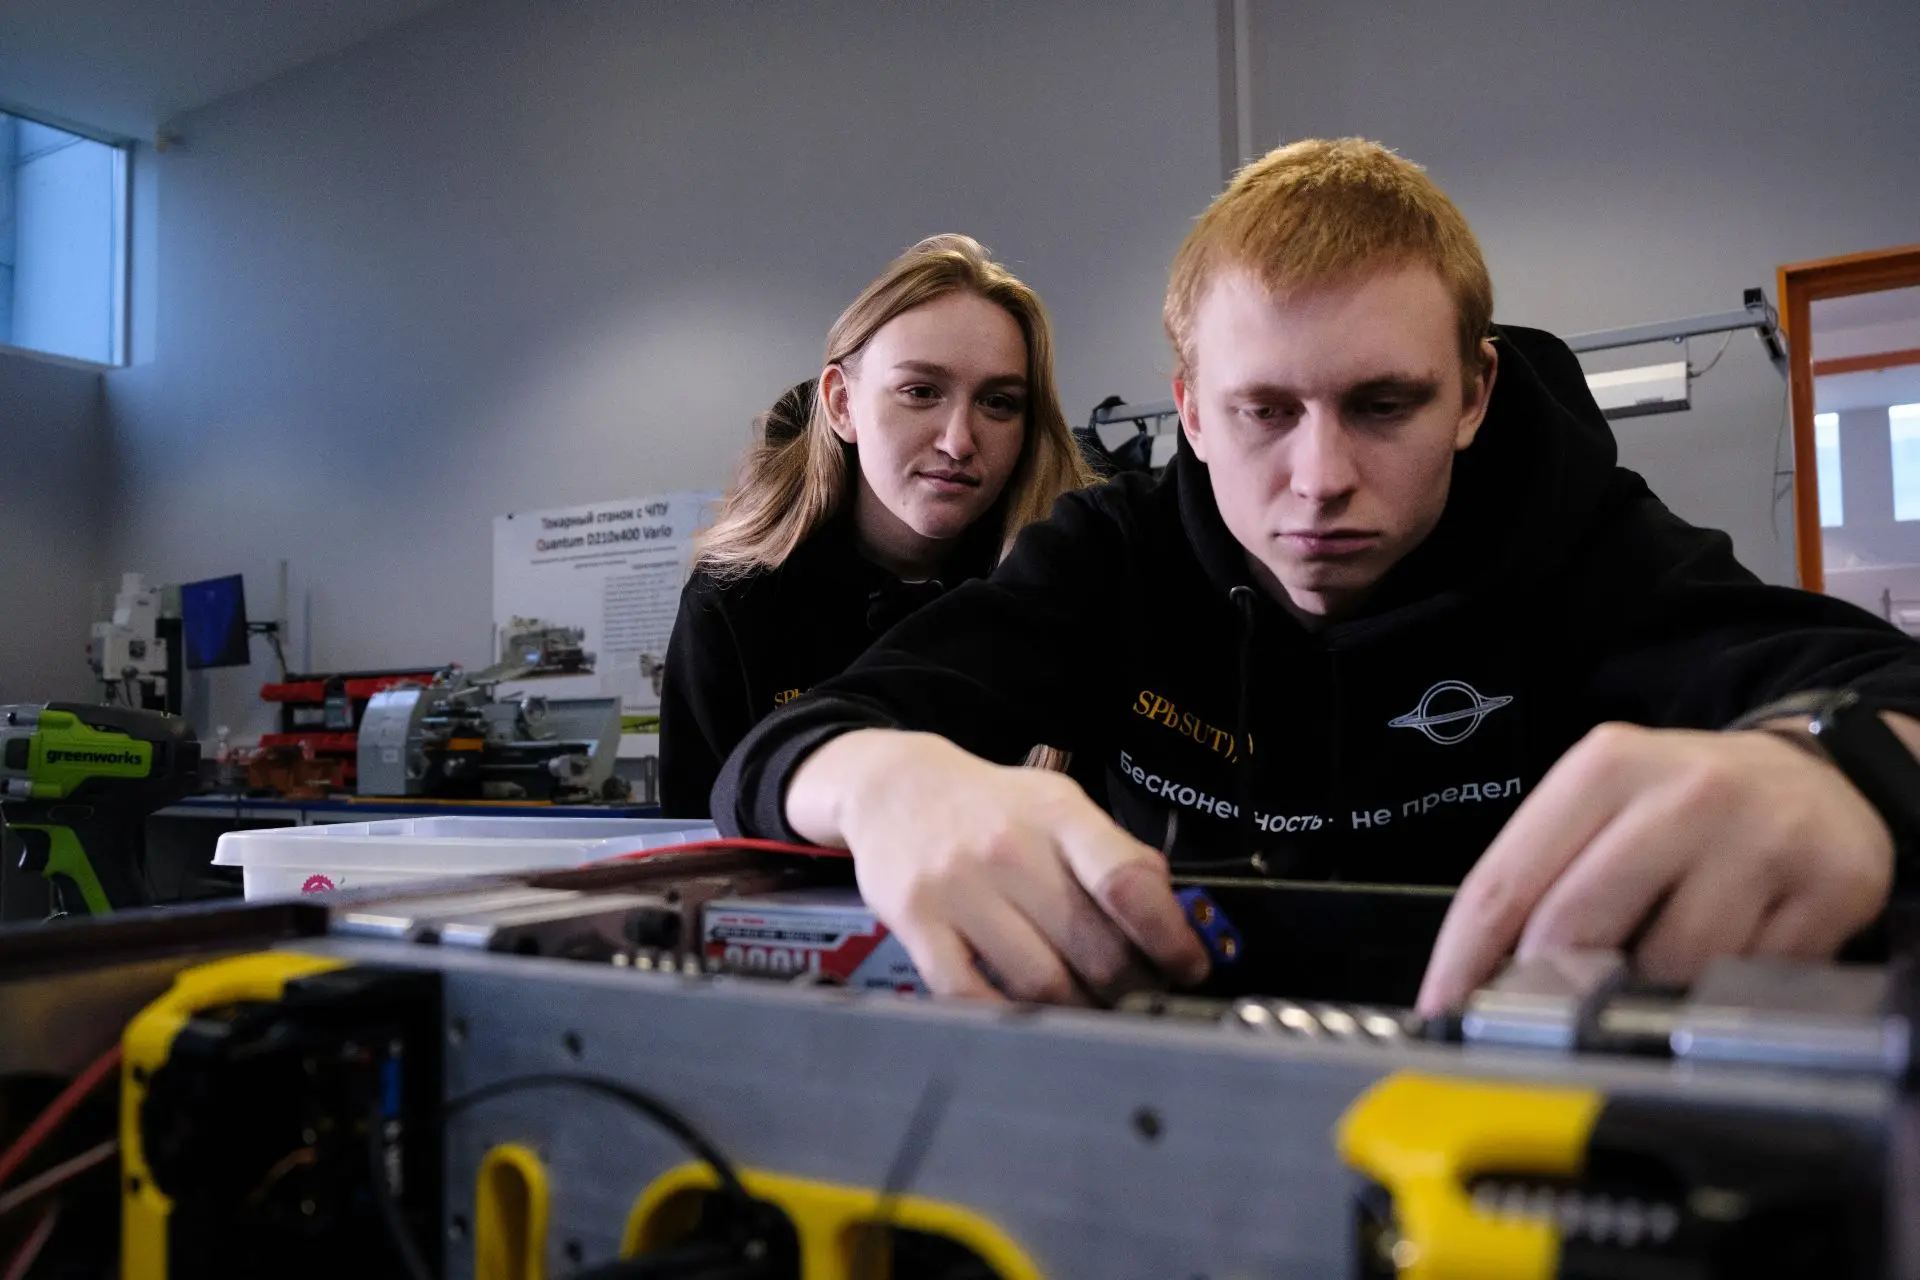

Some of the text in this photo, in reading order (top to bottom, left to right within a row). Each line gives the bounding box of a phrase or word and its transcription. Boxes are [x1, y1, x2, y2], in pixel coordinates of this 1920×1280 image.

[542, 502, 669, 529] Токарный станок с ЧПУ
[537, 536, 584, 552] Quantum
[643, 526, 673, 539] Vario
[46, 750, 142, 765] greenworks
[1351, 808, 1392, 830] не
[1402, 776, 1521, 818] предел
